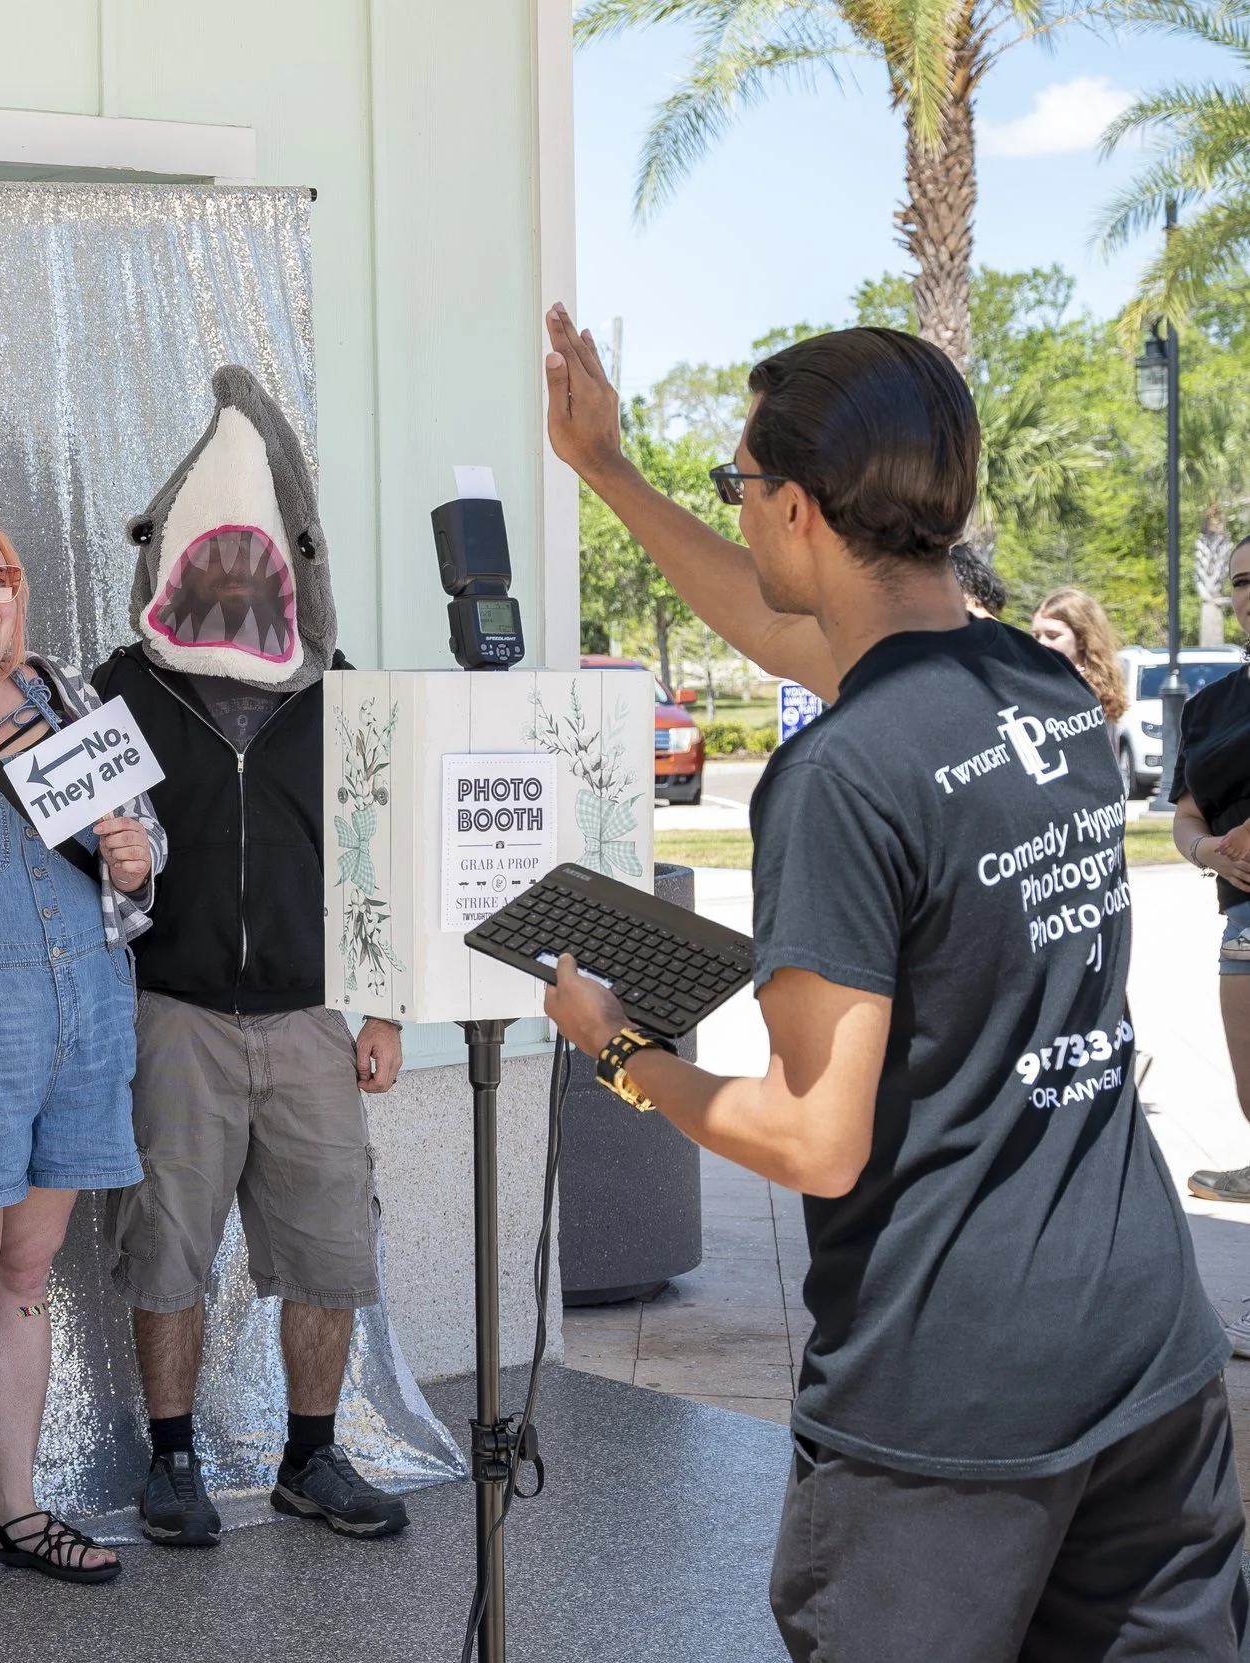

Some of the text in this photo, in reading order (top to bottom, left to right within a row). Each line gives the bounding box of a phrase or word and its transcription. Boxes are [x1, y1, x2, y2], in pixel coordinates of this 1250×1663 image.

[82, 729, 130, 760] No,
[935, 744, 1011, 794] TWYLIGHT
[1045, 704, 1104, 742] PRODUC
[30, 748, 140, 819] They are
[458, 777, 542, 802] PHOTO
[458, 808, 543, 832] BOOTH
[461, 857, 539, 871] GRAB A PROP
[978, 822, 1069, 886] Comedy
[455, 897, 499, 909] STRIKE
[1029, 903, 1101, 954] Photo
